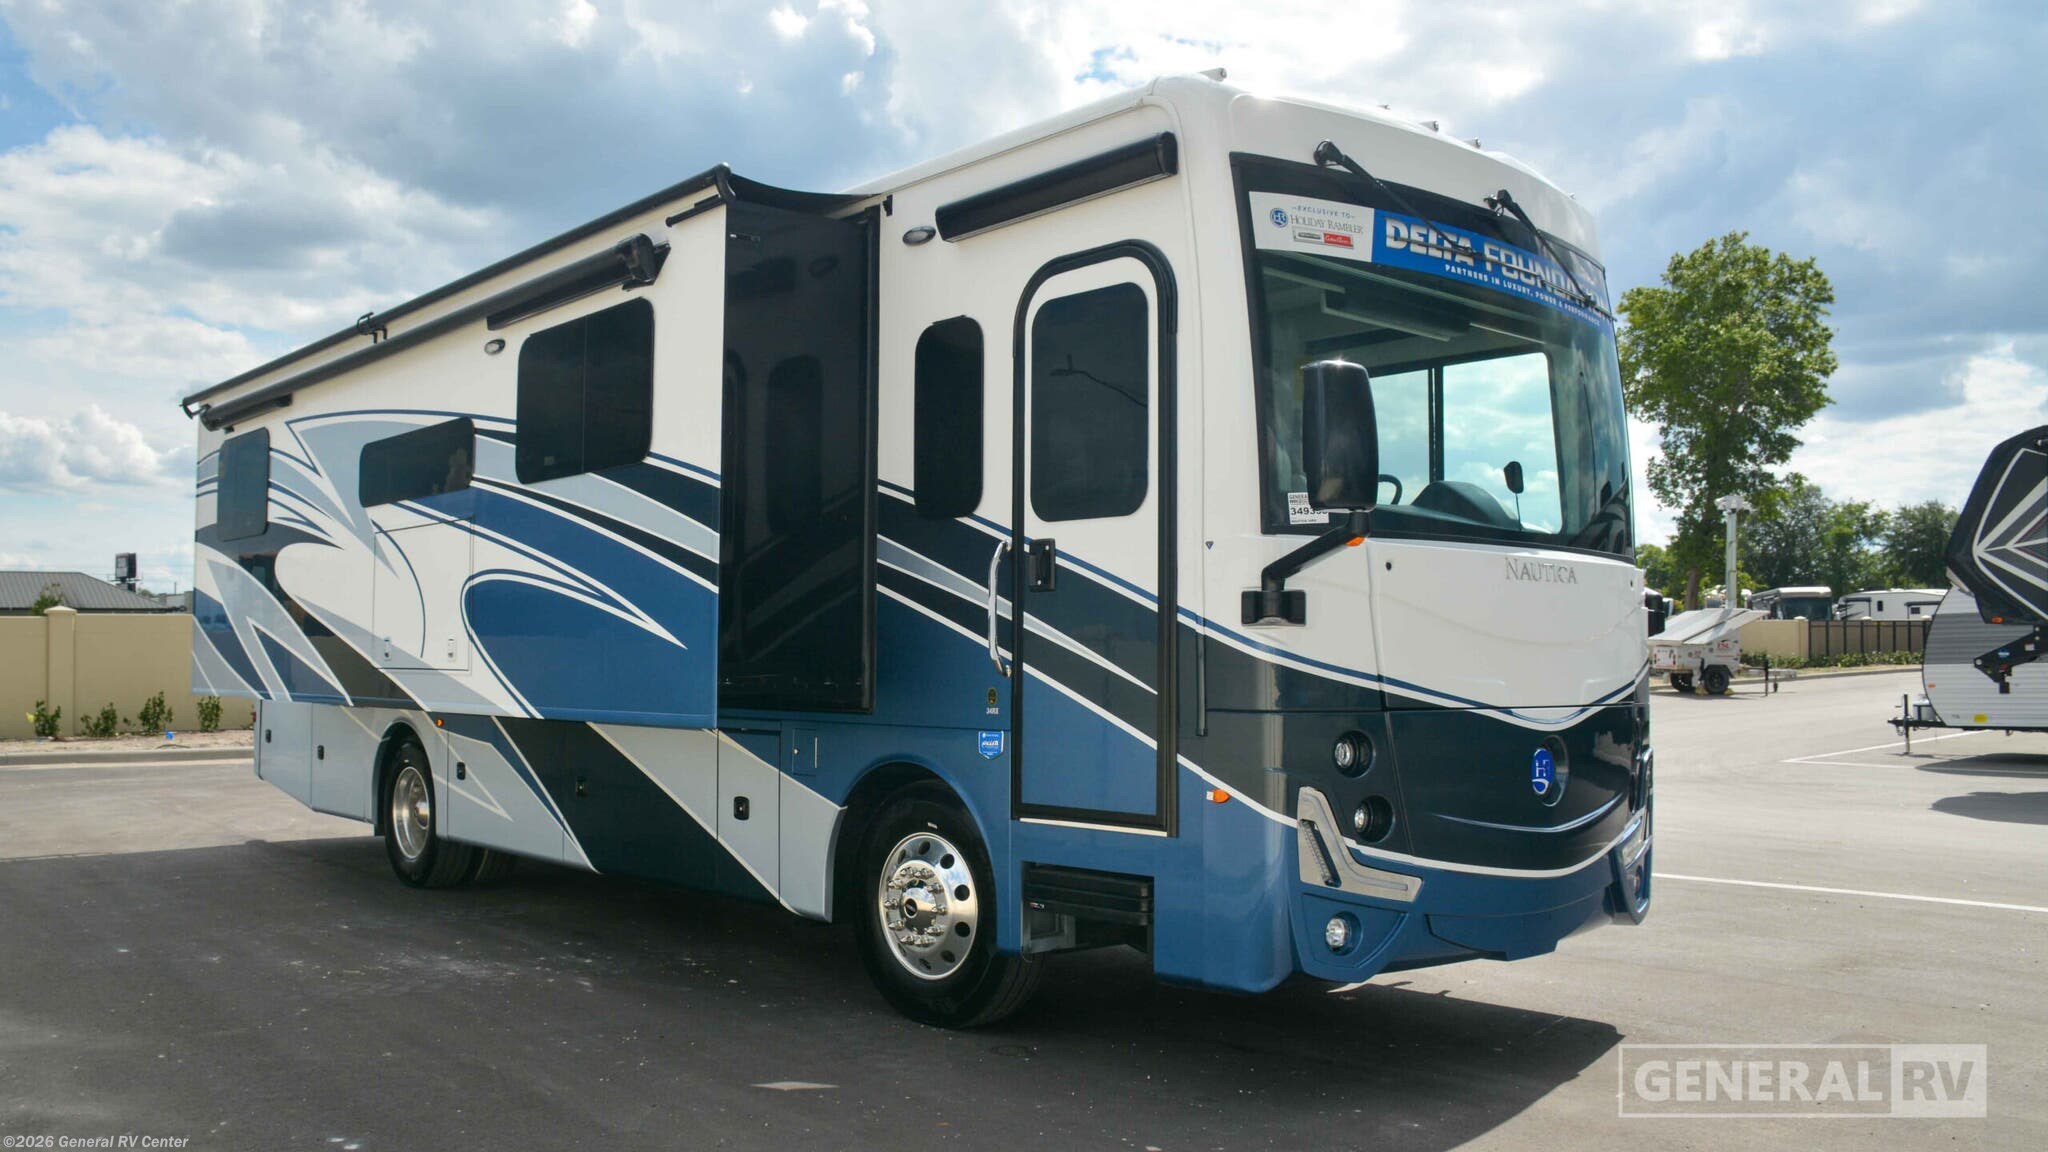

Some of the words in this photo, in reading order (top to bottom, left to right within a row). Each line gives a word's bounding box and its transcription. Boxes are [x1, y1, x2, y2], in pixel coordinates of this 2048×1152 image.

[1297, 205, 1338, 217] EXCLUSIVE
[1385, 218, 1475, 267] DELTA
[1445, 264, 1488, 282] PARTNERS
[1491, 276, 1500, 285] IN
[1535, 291, 1557, 307] POWER
[1505, 557, 1578, 585] NAUTICA
